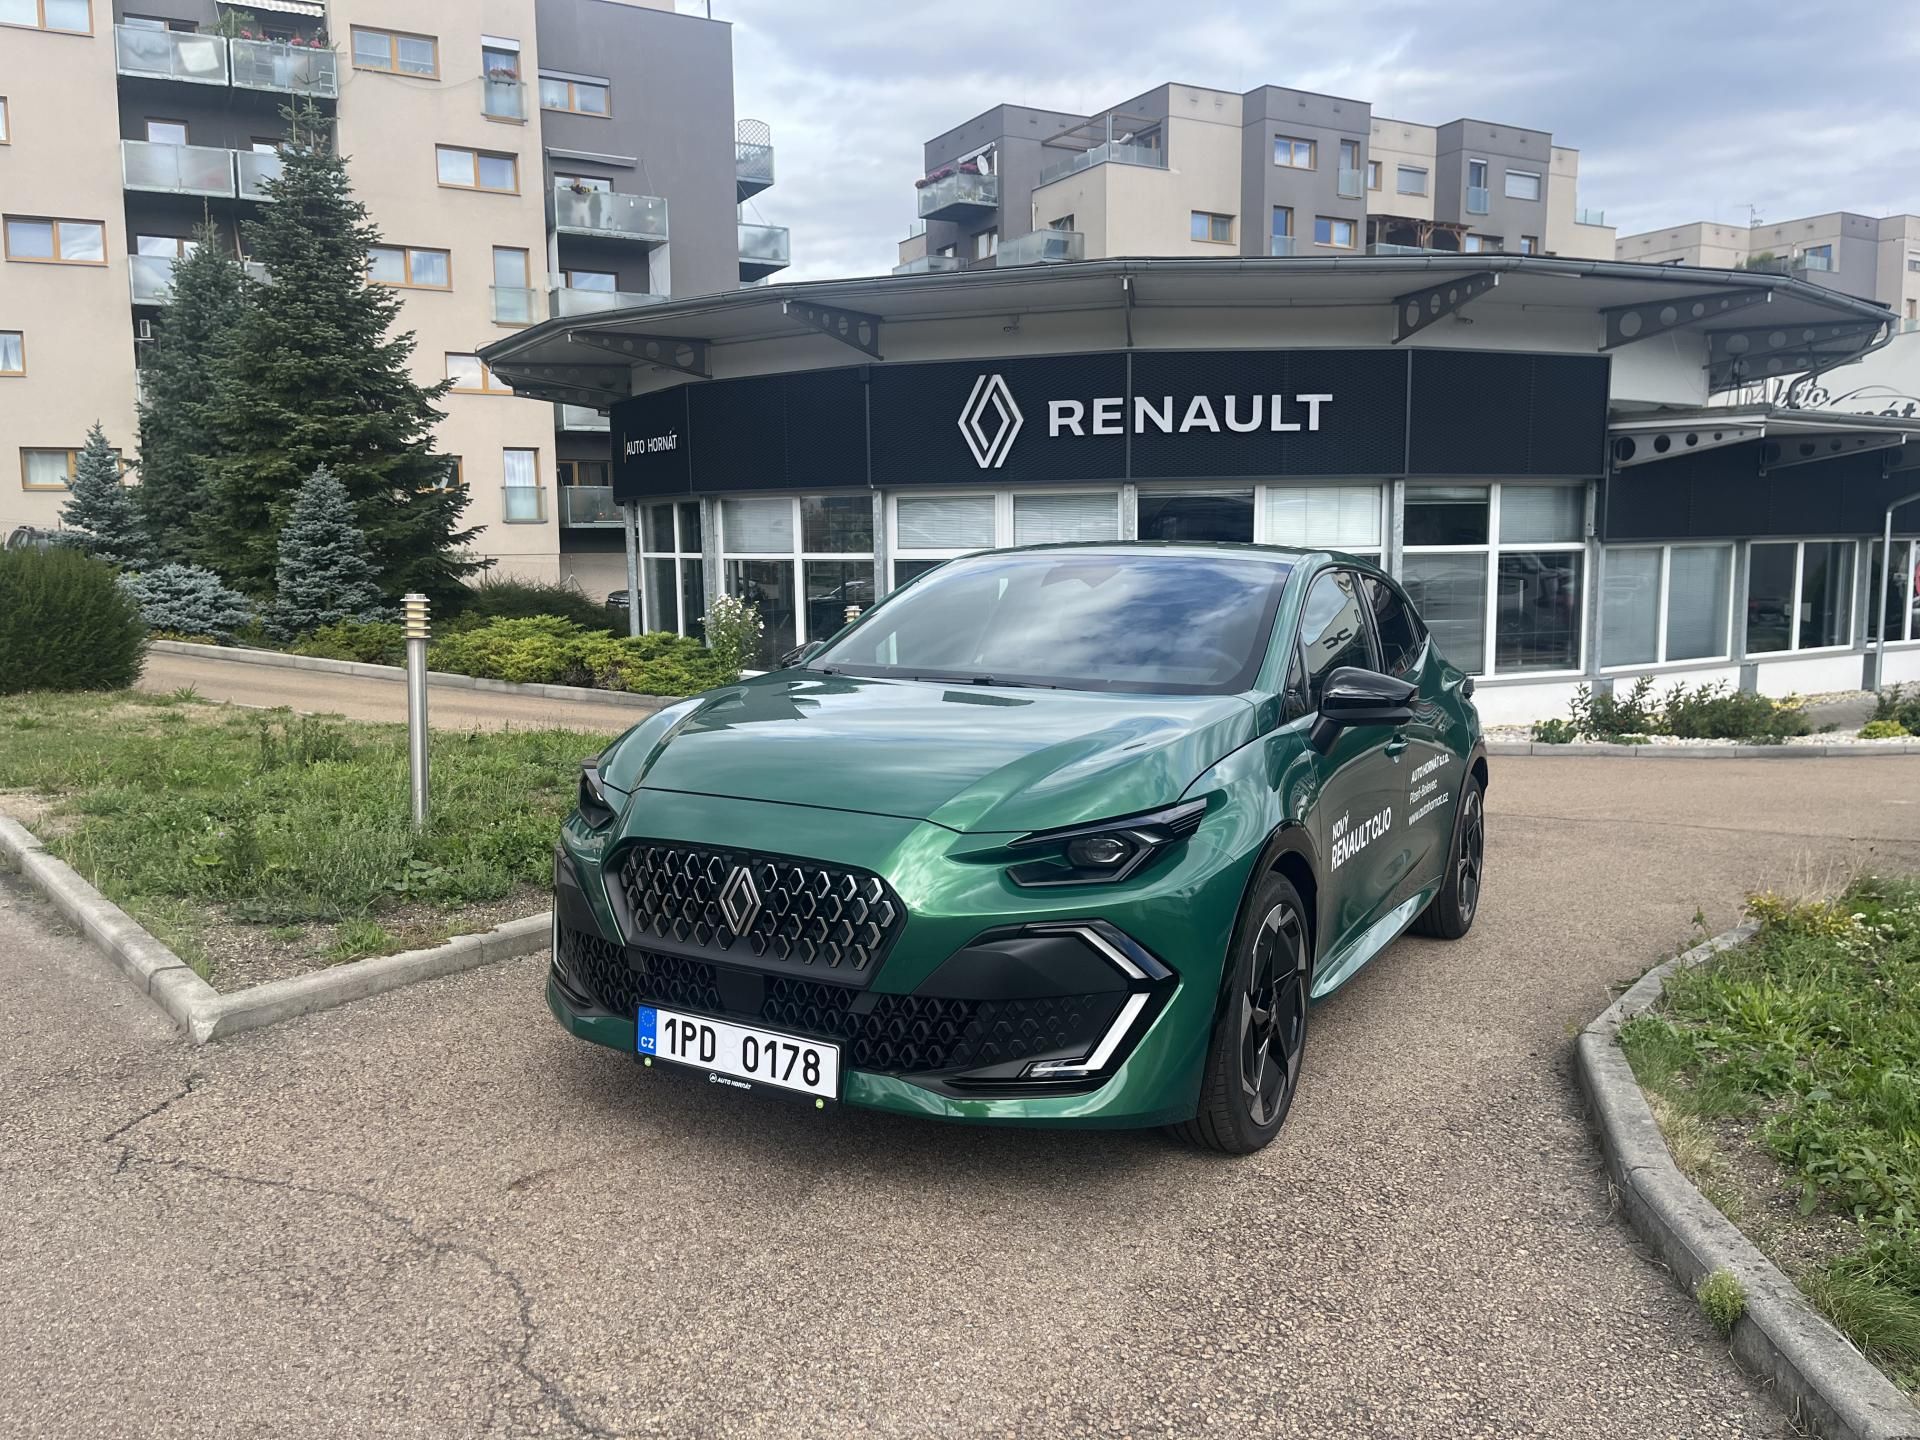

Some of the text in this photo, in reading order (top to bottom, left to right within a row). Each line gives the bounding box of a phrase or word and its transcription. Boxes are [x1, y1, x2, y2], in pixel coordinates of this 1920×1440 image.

[1047, 393, 1334, 438] RENAULT
[626, 430, 678, 456] AUTO HORNÁT
[1331, 806, 1392, 872] RENAULT CLIO
[1332, 809, 1349, 842] NOVÝ
[640, 1036, 655, 1049] CZ
[664, 1017, 821, 1087] 1PD 0178
[717, 1077, 731, 1086] AUTO
